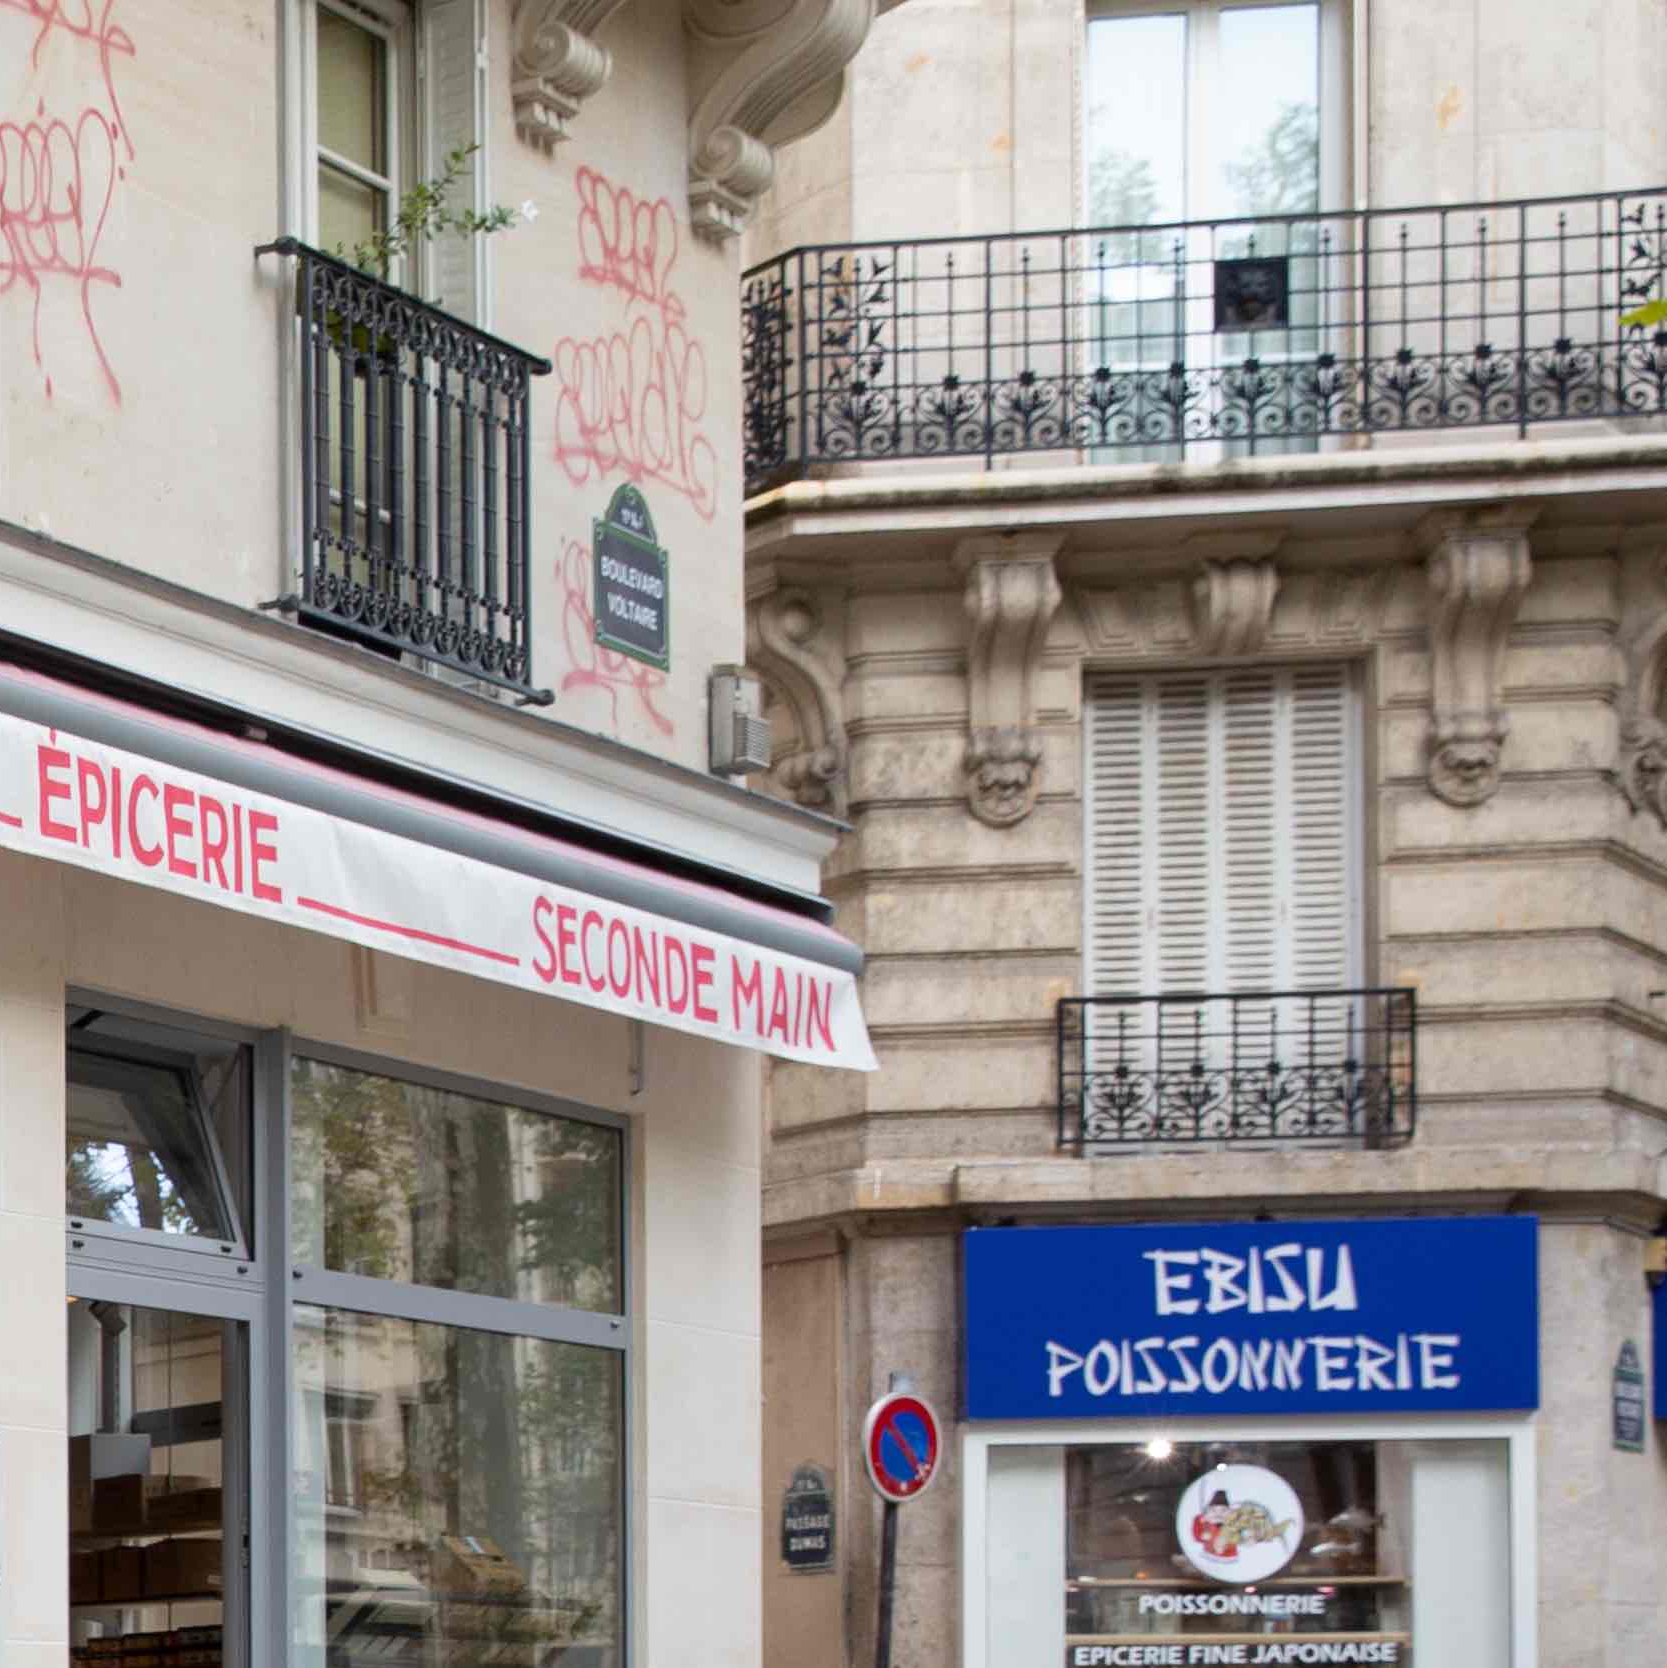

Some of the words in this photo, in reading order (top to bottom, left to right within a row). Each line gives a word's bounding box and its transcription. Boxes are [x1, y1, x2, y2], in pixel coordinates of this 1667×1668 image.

[599, 554, 665, 600] BOULEVARD
[606, 590, 659, 632] VOLTAIRE
[35, 727, 284, 905] ÉPICERIE
[531, 895, 720, 1025] SECONDE
[728, 956, 836, 1053] MAIN
[1143, 1243, 1358, 1315] EBISU
[1045, 1334, 1461, 1397] POISSONNERIE
[1138, 1593, 1328, 1616] POISSONNERIE
[1074, 1646, 1184, 1667] EPICERIE
[1188, 1644, 1249, 1665] FINE
[1251, 1642, 1398, 1664] JAPONAISE
